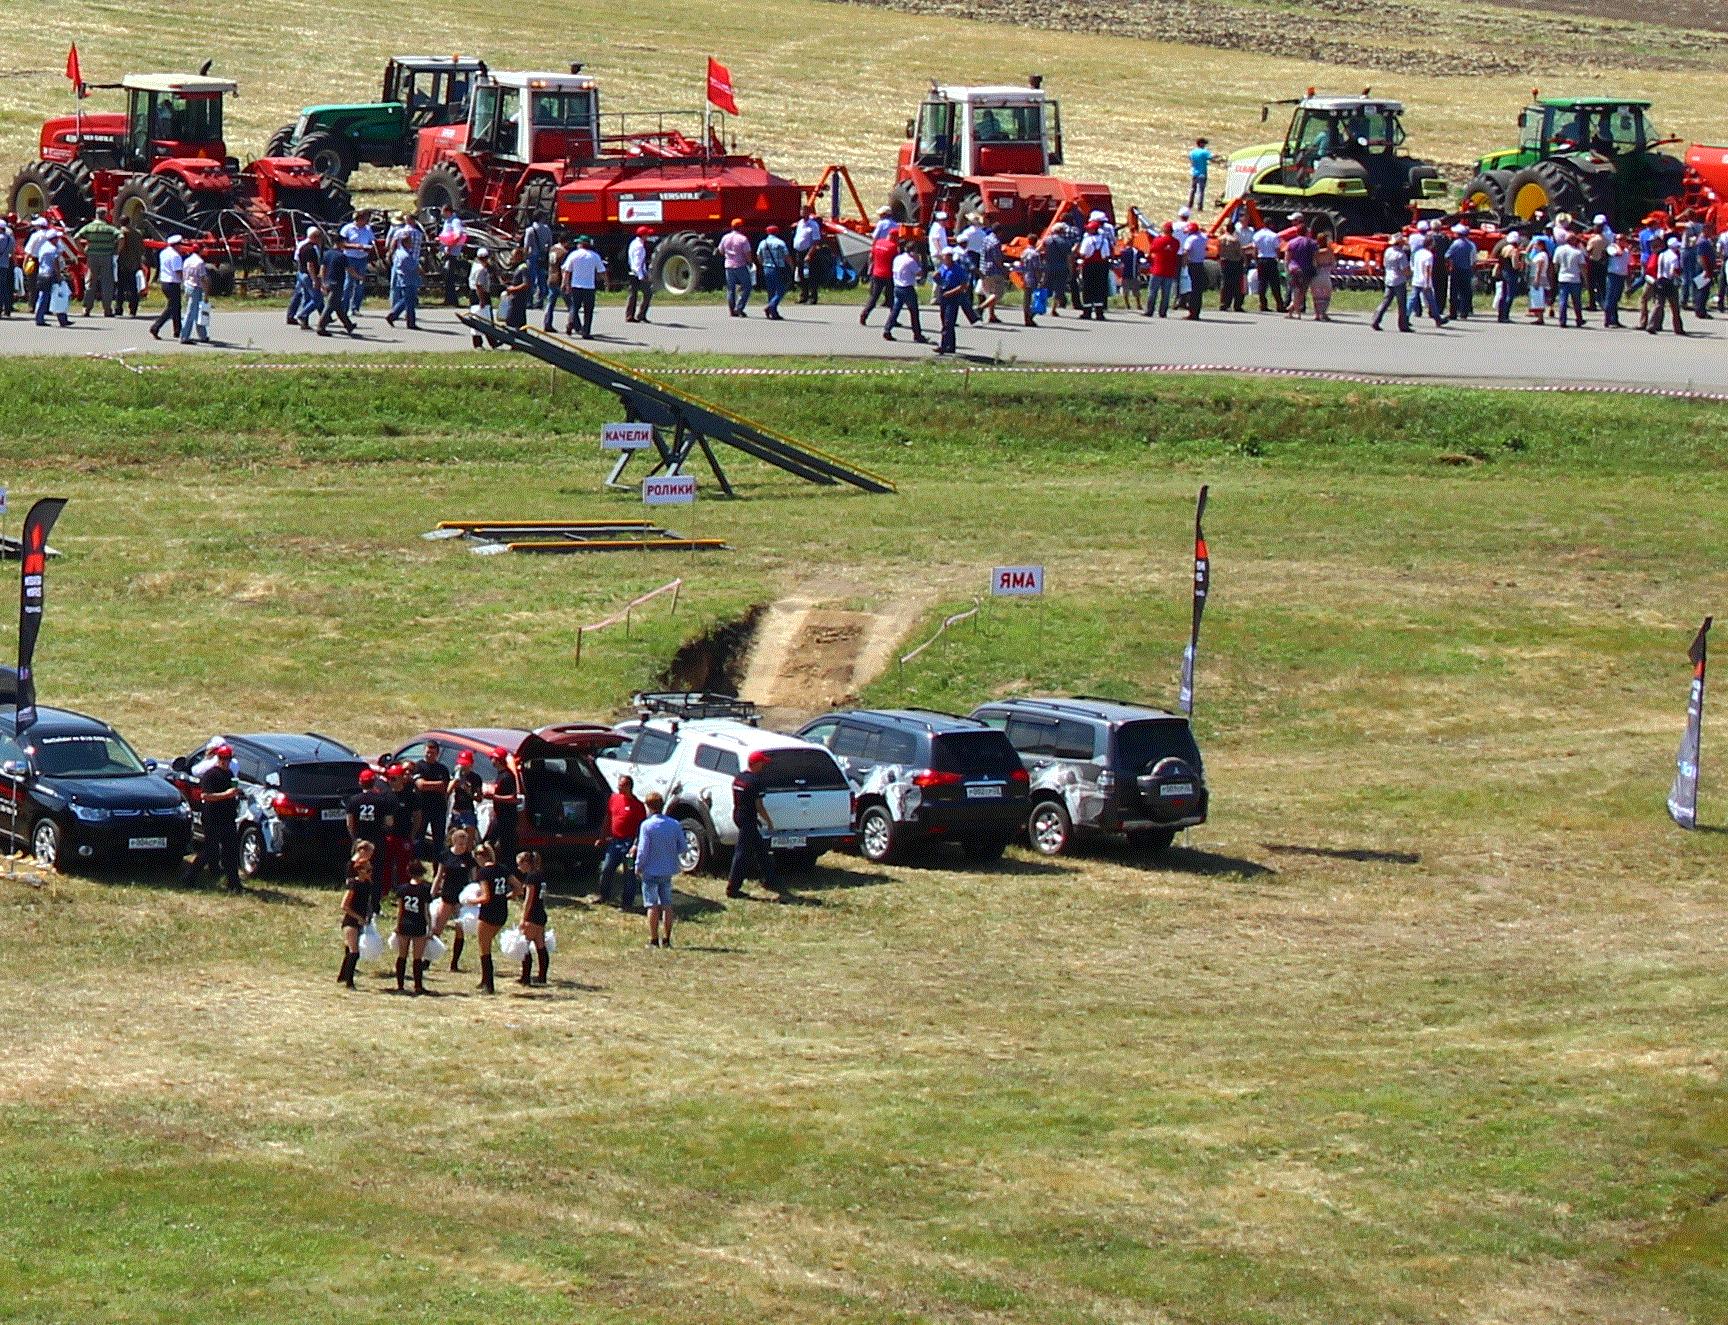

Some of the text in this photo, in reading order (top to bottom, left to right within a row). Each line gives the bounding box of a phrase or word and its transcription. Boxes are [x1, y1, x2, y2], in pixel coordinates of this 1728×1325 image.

[659, 192, 700, 200] VERSATILE
[605, 430, 649, 441] КАЧЕЛИ
[647, 484, 693, 495] РОЛИКИ
[1000, 572, 1035, 589] ЯМА
[359, 805, 375, 815] 22
[494, 877, 506, 888] 22
[404, 896, 419, 907] 22
